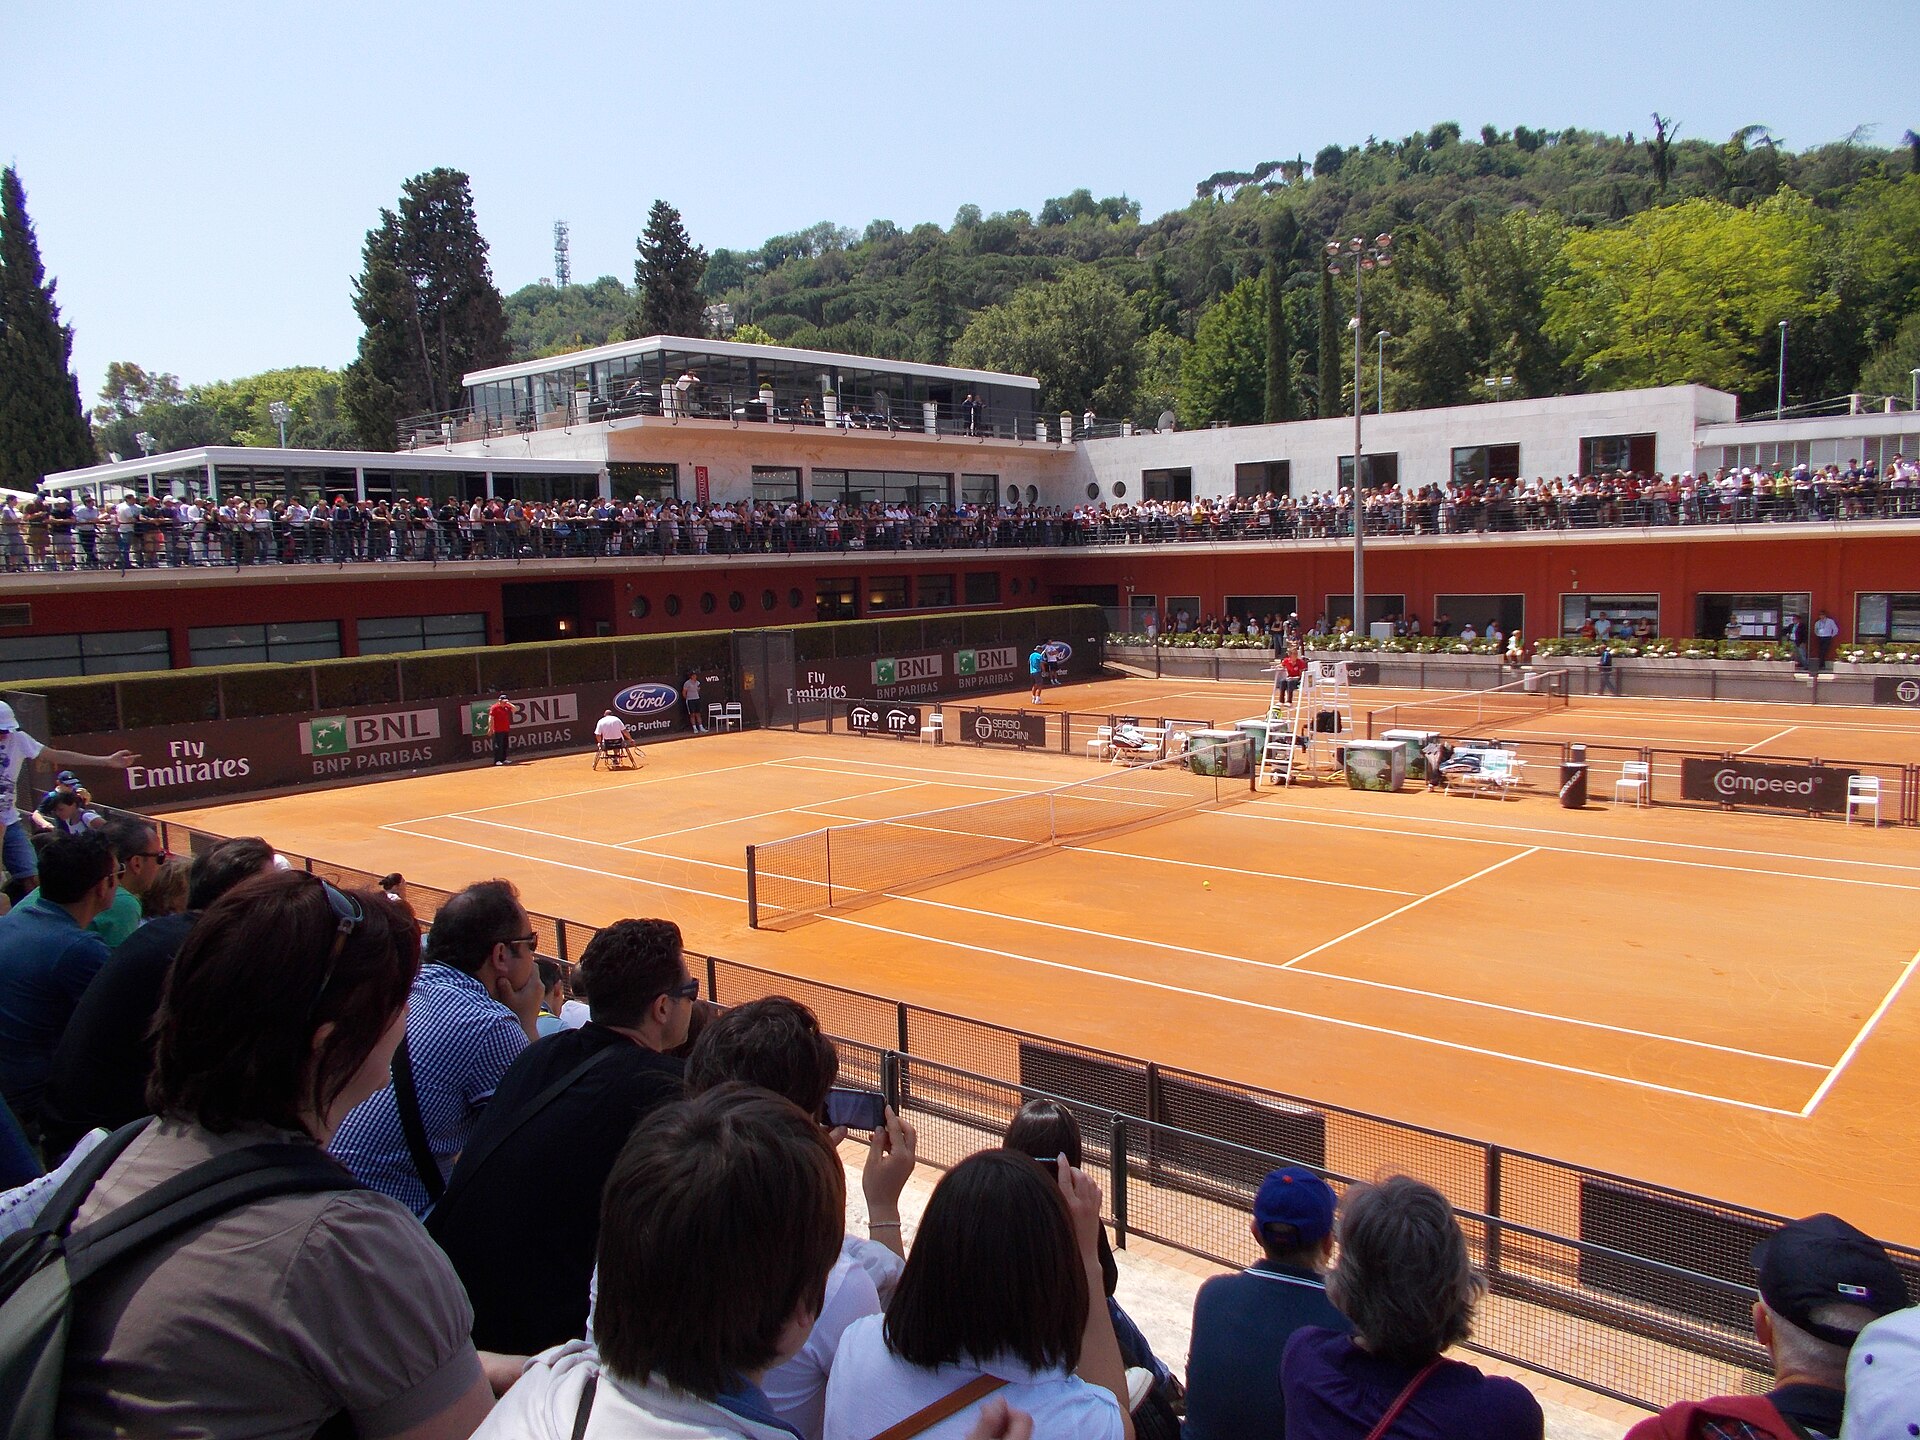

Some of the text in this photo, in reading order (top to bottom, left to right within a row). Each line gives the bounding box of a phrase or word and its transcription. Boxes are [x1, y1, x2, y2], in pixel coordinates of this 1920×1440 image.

[900, 658, 937, 678] BNL
[979, 650, 1013, 669] BNL
[808, 671, 825, 684] Fly
[959, 672, 1014, 688] BNP PARIBAS
[626, 689, 666, 710] Ford
[787, 685, 847, 704] Emirates
[877, 682, 938, 699] BNP PARIBAS
[508, 698, 570, 725] BNL
[853, 714, 870, 726] ITF
[354, 714, 430, 744] BNL
[625, 720, 670, 732] Go Further
[889, 716, 907, 729] ITF
[993, 719, 1020, 730] SERGIO
[472, 728, 572, 753] BN PARIBAS
[993, 729, 1029, 740] TACCHINI
[169, 740, 204, 758] Fly
[313, 747, 433, 775] BNP PARIBAS
[126, 757, 250, 790] Emirates
[1713, 768, 1813, 795] Compeed
